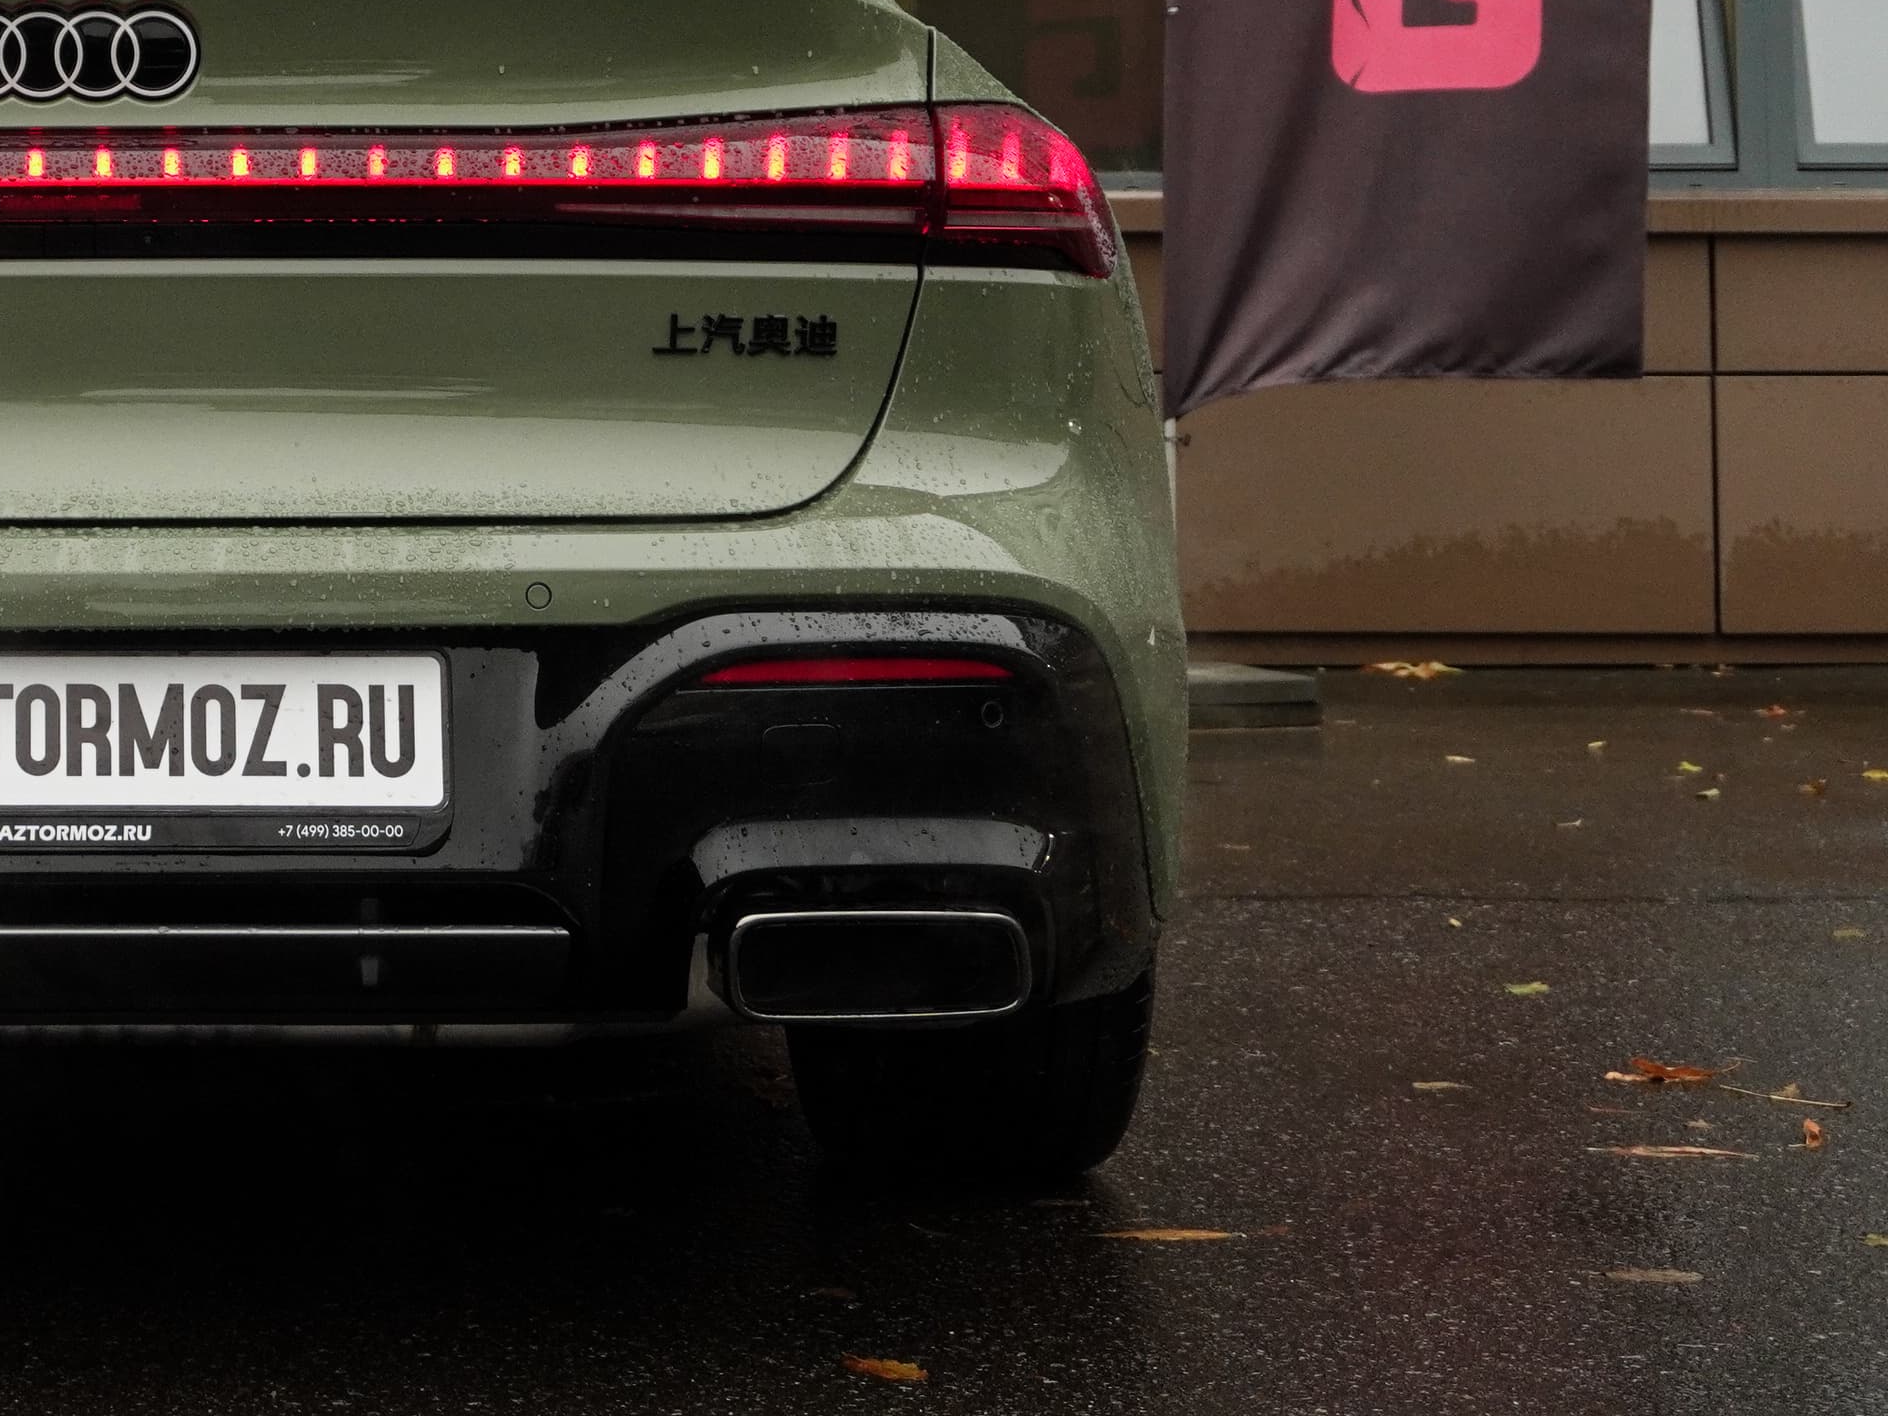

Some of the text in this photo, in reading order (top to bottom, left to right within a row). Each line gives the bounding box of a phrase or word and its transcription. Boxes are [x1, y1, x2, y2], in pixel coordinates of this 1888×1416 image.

[651, 313, 838, 356] 上汽奥迪
[277, 823, 405, 839] +7 (499) 385-00-00
